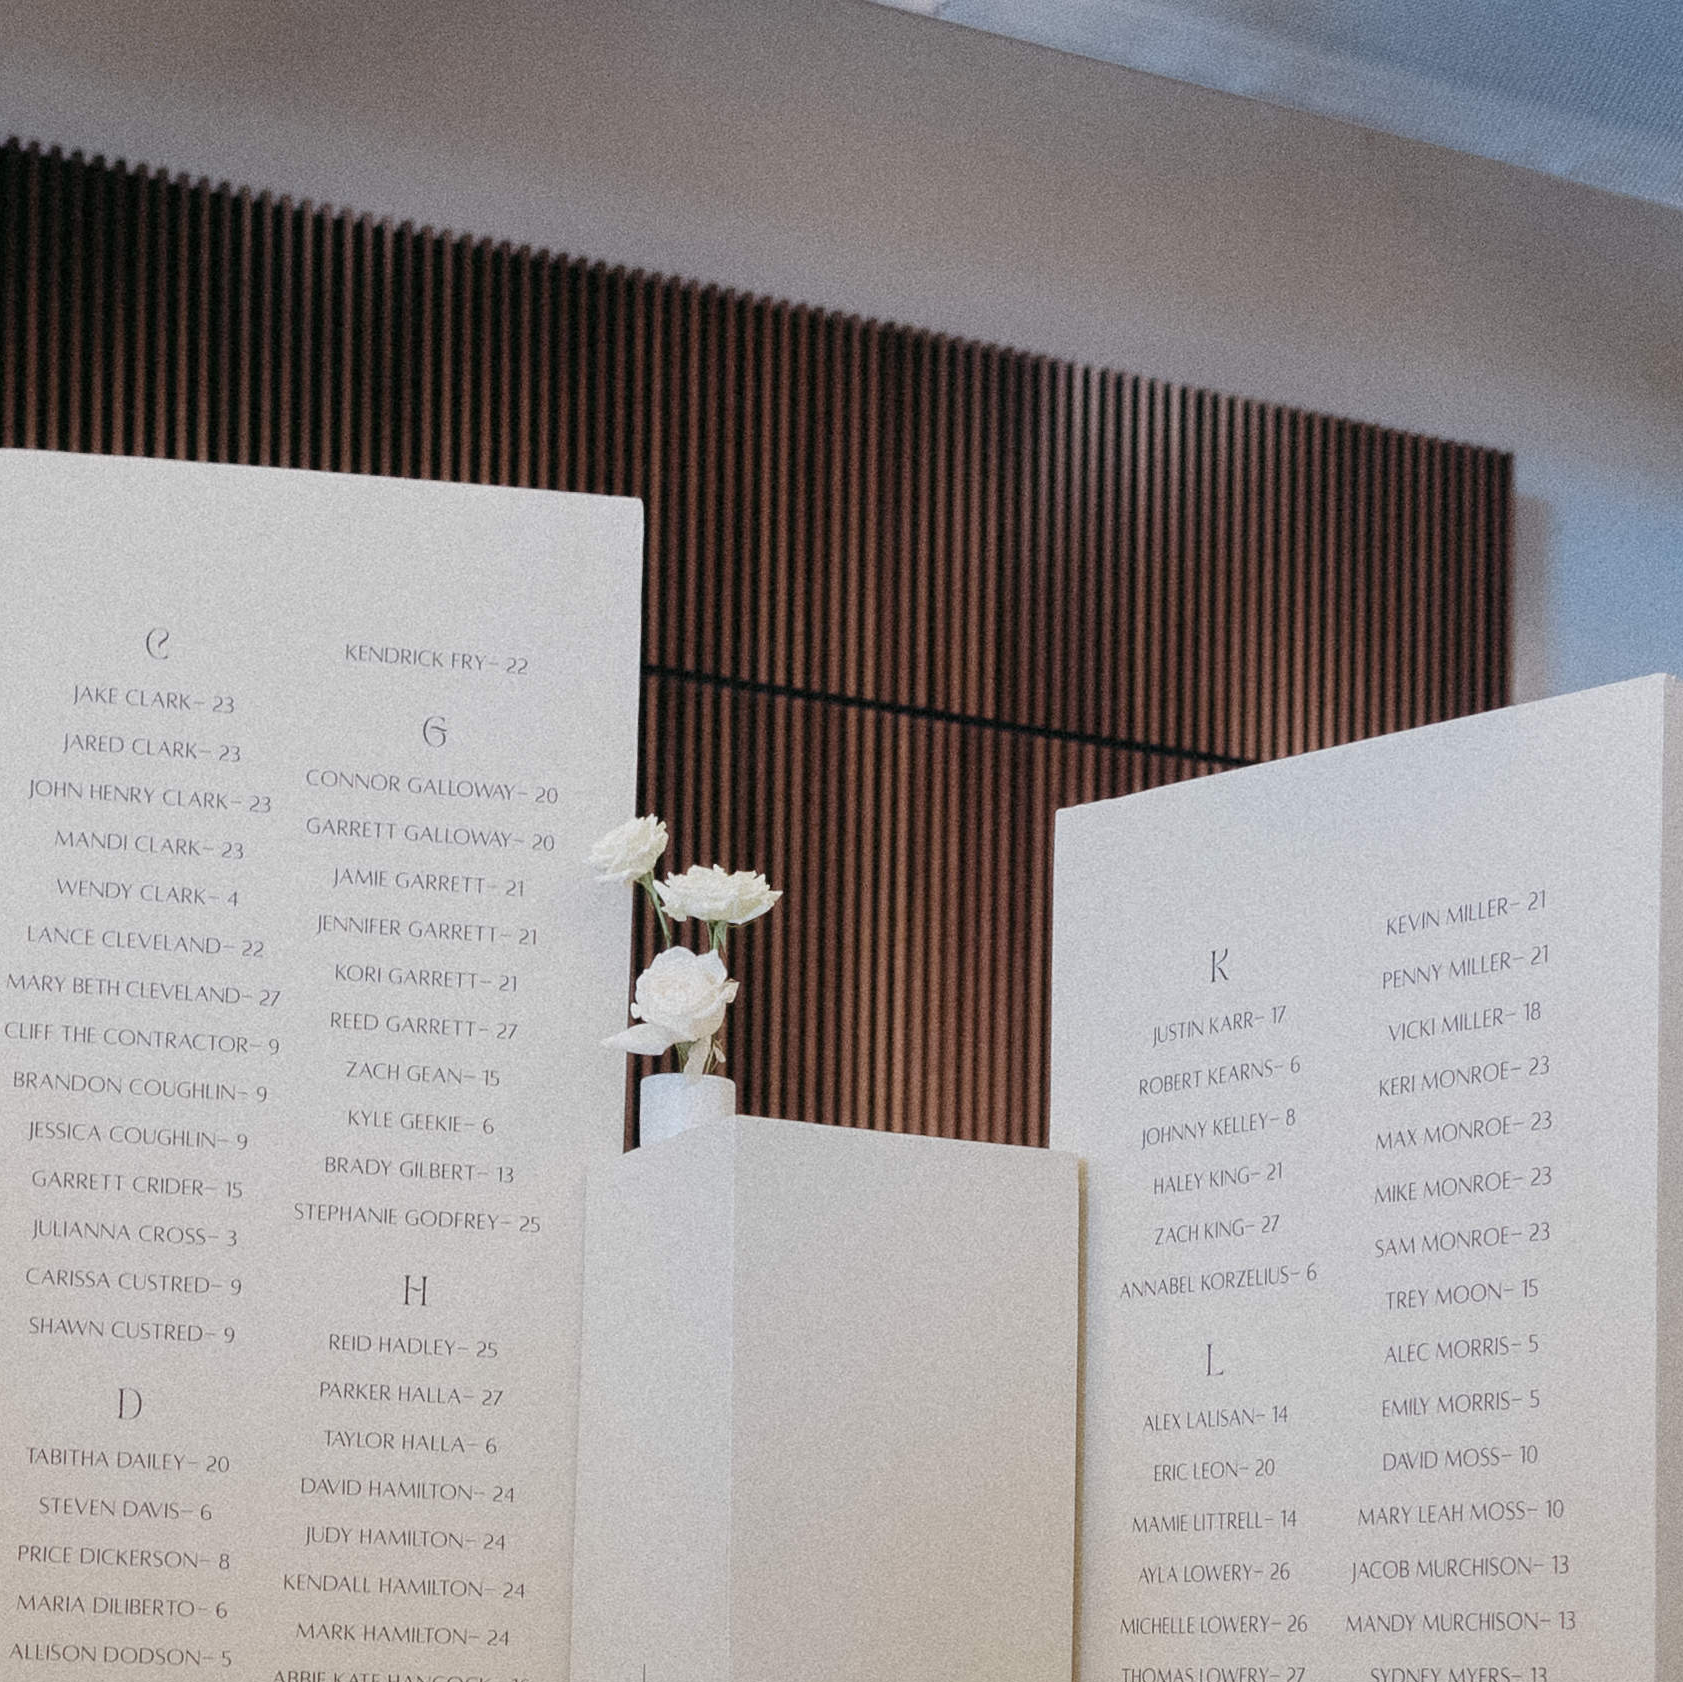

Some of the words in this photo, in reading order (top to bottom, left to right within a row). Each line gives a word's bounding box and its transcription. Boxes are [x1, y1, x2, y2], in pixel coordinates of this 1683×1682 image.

[146, 627, 169, 660] C
[346, 644, 443, 668] KENDRICK
[507, 657, 528, 675] 22
[74, 684, 117, 704] JAKE
[213, 695, 234, 714] 23
[423, 716, 447, 747] G
[29, 779, 82, 799] JOHN
[91, 784, 153, 804] HENRY
[250, 795, 271, 813] 23
[306, 769, 400, 792] CONNOR
[536, 787, 558, 804] 20
[1387, 911, 1439, 936] KEVIN
[1528, 889, 1545, 911] 21
[1211, 948, 1228, 983] K
[5, 1022, 52, 1040] CLIFF
[63, 1025, 94, 1044] THE
[269, 1039, 279, 1055] 9
[1153, 1020, 1203, 1047] JUSTIN
[1273, 1006, 1286, 1024] 17
[32, 1170, 123, 1191] GARRETT
[227, 1181, 242, 1198] 15
[325, 1156, 391, 1175] BRADY
[498, 1167, 514, 1183] 13
[1375, 1237, 1415, 1258] SAM
[1530, 1221, 1549, 1242] 23
[404, 1274, 427, 1307] H
[1121, 1276, 1193, 1298] ANNABEL
[1307, 1262, 1317, 1281] 6
[329, 1334, 372, 1351] REID
[477, 1341, 497, 1358] 25
[1207, 1342, 1224, 1377] L
[118, 1388, 142, 1420] D
[320, 1381, 390, 1401] PARKER
[482, 1390, 503, 1406] 27
[27, 1447, 108, 1467] TABITHA
[206, 1455, 229, 1473] 20
[1154, 1463, 1186, 1482] ERIC
[1256, 1458, 1274, 1477] 20
[1383, 1450, 1438, 1471] DAVID
[1521, 1445, 1538, 1464] 10
[18, 1545, 71, 1564] PRICE
[219, 1553, 229, 1570] 8
